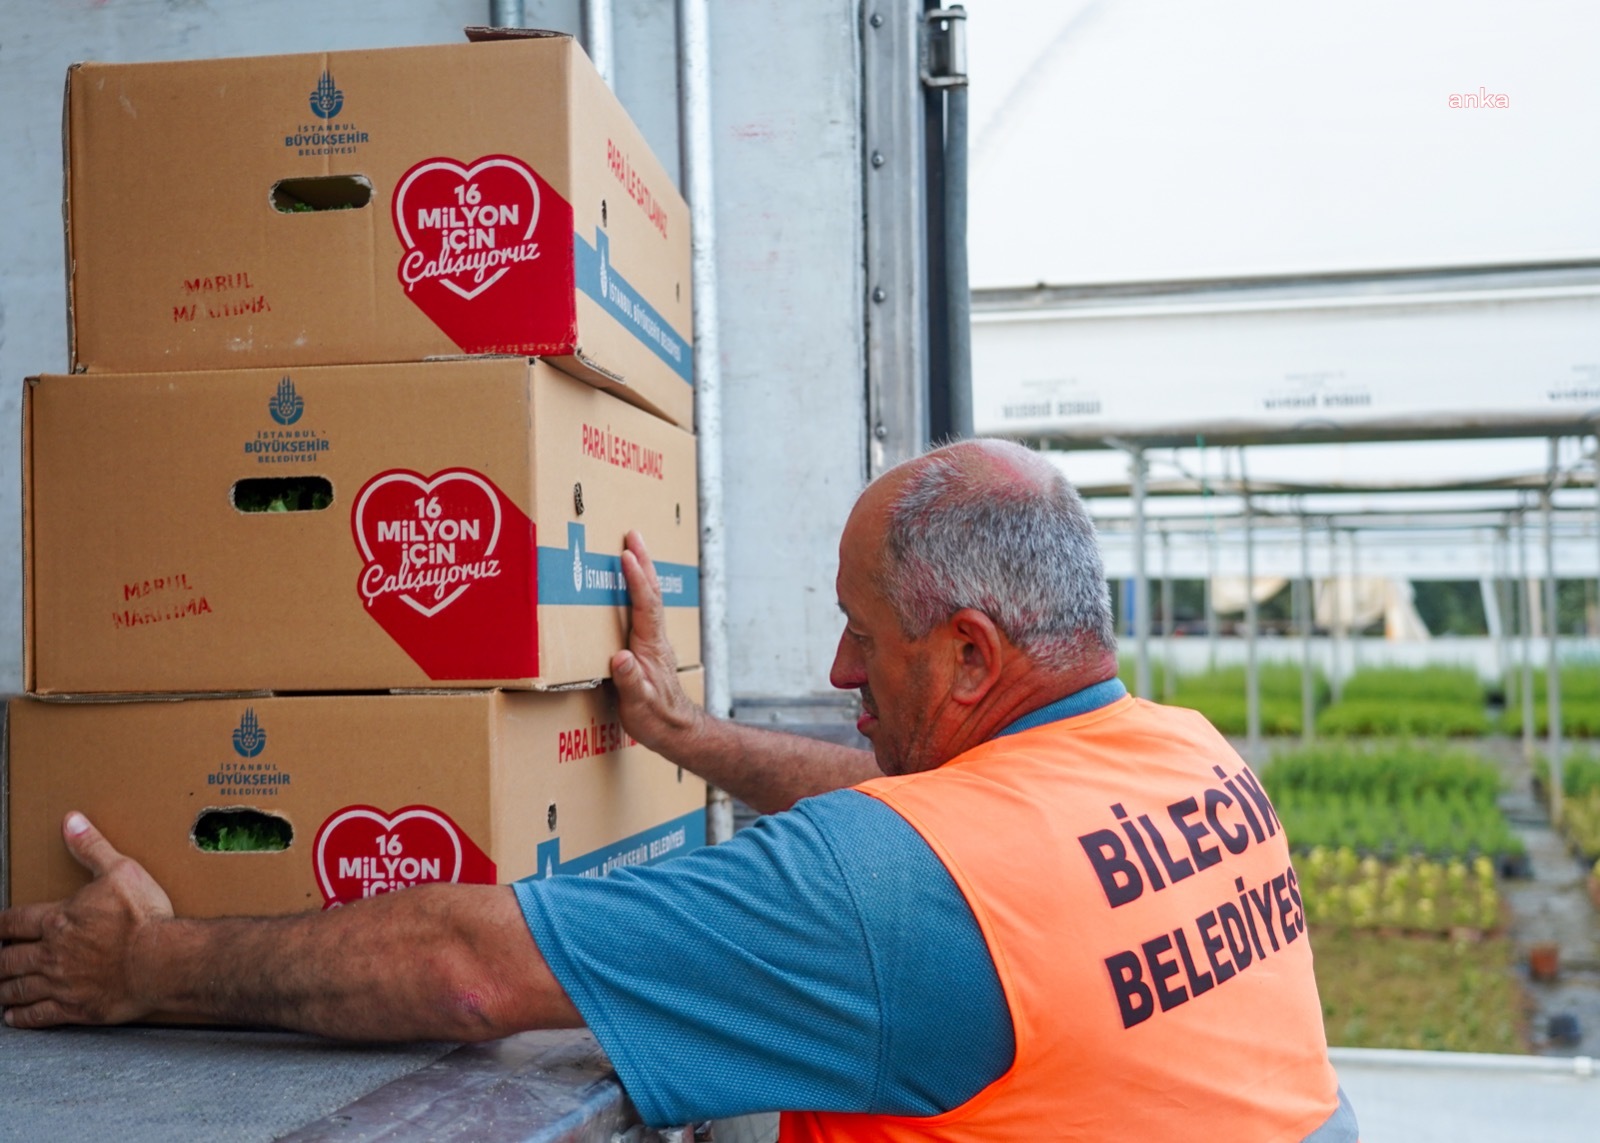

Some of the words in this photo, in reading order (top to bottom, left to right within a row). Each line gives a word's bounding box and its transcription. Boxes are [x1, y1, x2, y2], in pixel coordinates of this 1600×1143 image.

[285, 132, 369, 147] BÜYÜKŞEHİR
[298, 146, 357, 156] BELEDİYESİ
[454, 183, 482, 205] 16
[402, 242, 541, 292] Çalışıyoruz
[257, 430, 317, 439] İSTANBUL
[582, 423, 606, 462] PARA
[607, 424, 620, 467] İLE
[244, 438, 330, 454] BÜYÜKŞEHİR
[257, 453, 317, 463] BELEDİYESİ
[414, 496, 442, 519] 16
[361, 559, 501, 607] Çalışıyoruz
[559, 727, 590, 764] PARA
[591, 717, 607, 756] İLE
[220, 762, 278, 771] İSTANBUL
[207, 771, 291, 786] BÜYÜKŞEHİR
[220, 787, 278, 796] BELEDİYESİ
[375, 834, 403, 856] 16
[1077, 764, 1281, 910] BİLECİK
[1104, 866, 1305, 1029] BELEDİYES
